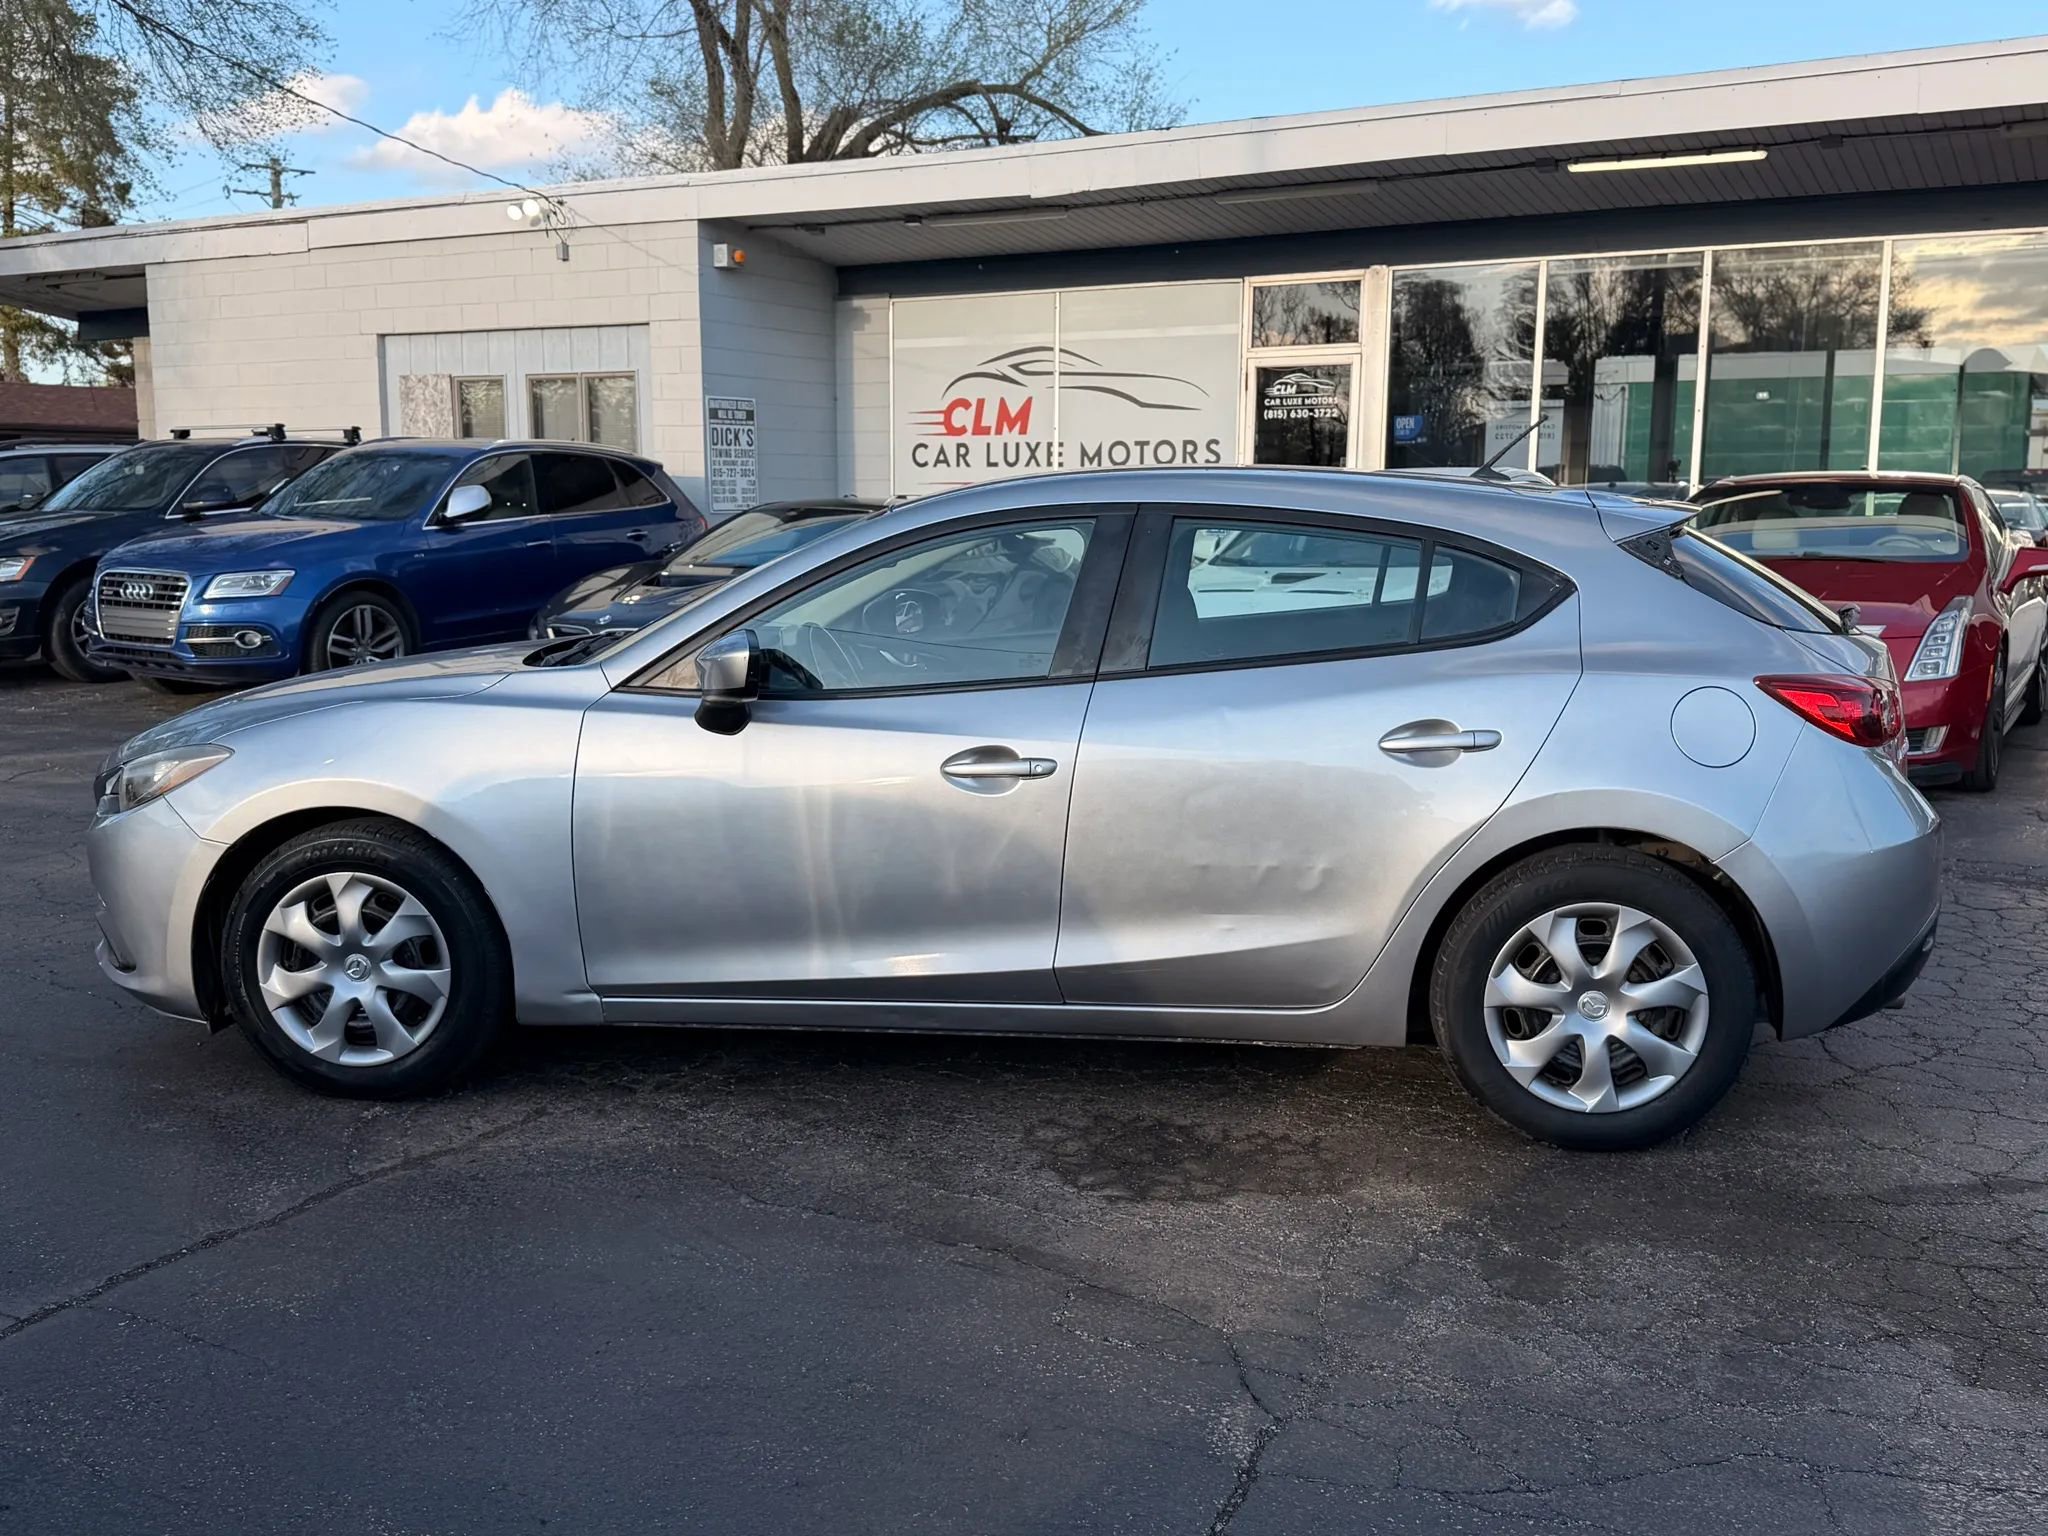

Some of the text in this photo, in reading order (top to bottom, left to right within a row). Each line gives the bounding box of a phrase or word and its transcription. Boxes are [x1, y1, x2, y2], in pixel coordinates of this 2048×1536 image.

[1273, 385, 1297, 394] CLM
[1264, 398, 1281, 406] CAR
[1305, 397, 1338, 405] MOTORS
[943, 396, 1033, 436] CLM
[1264, 409, 1338, 420] (815) 630-3722
[1396, 417, 1415, 429] OPEN
[711, 427, 754, 447] DICK'S
[711, 448, 755, 459] TOWING SERVICE
[912, 438, 1222, 468] CAR LUXE MOTORS
